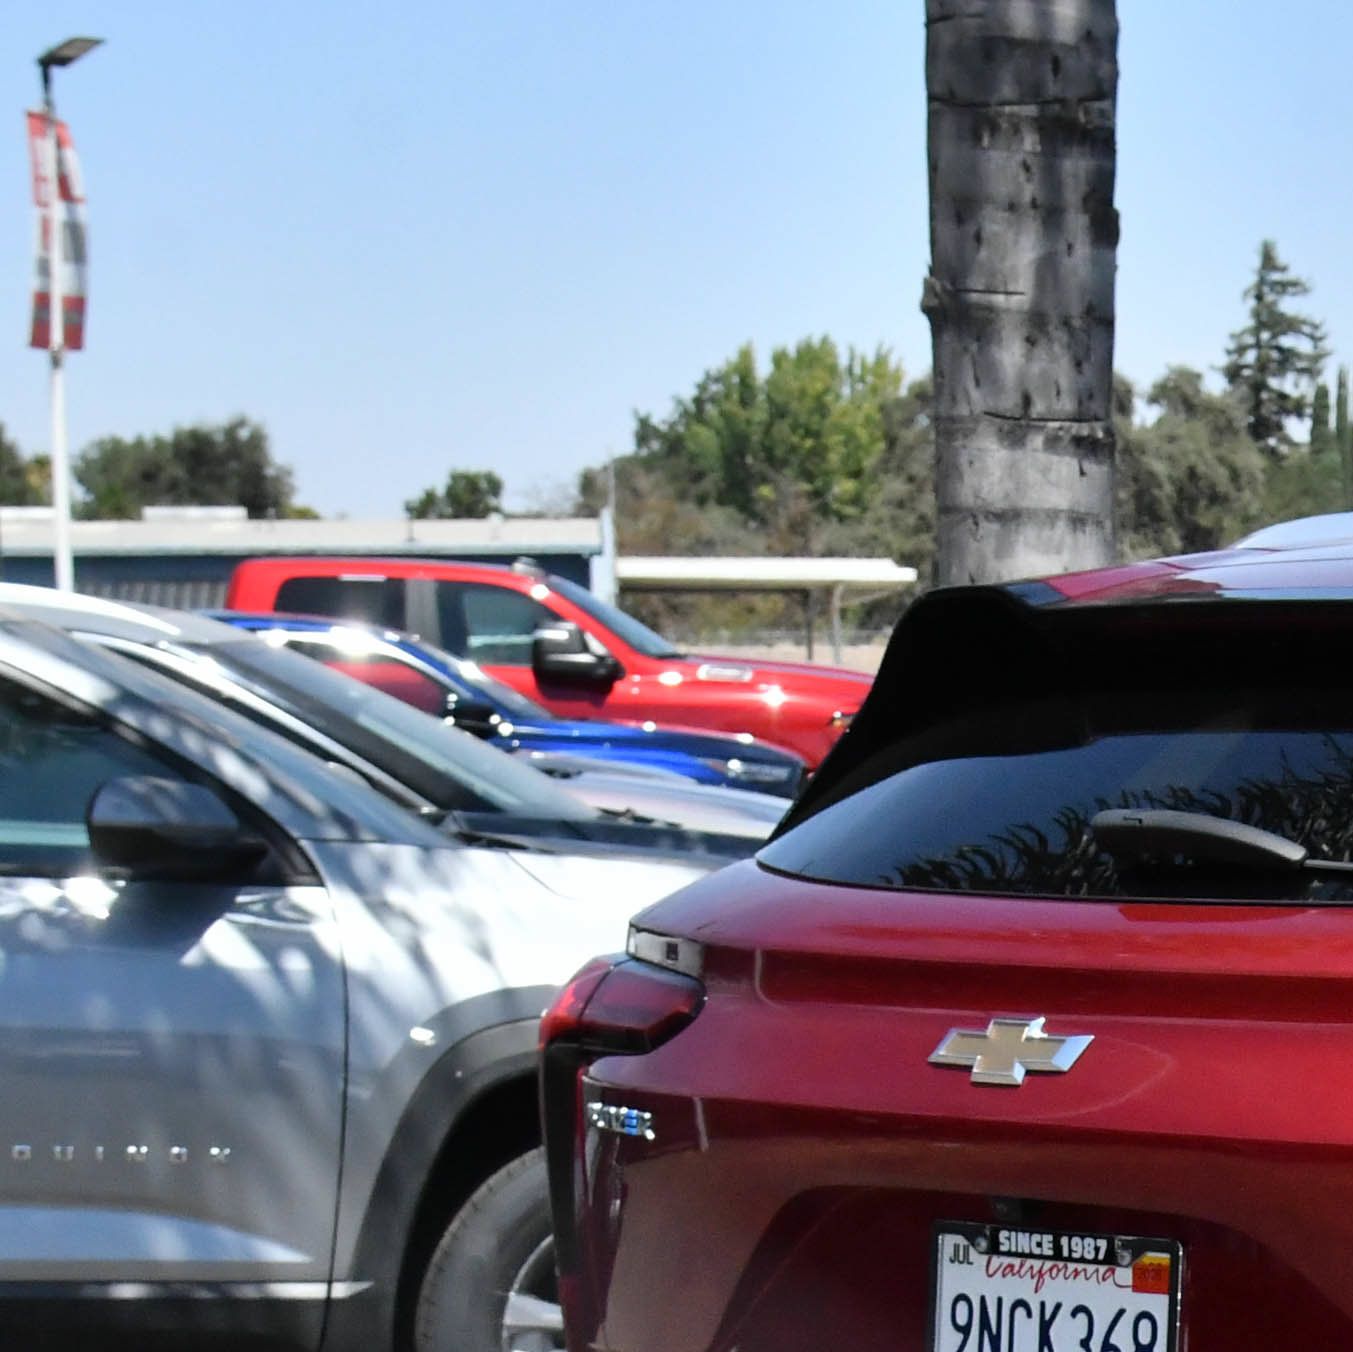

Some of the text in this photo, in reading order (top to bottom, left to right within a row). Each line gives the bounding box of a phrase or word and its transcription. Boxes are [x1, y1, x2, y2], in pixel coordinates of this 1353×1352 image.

[949, 1242, 974, 1266] JUL
[998, 1230, 1108, 1261] SINCE 1987
[985, 1254, 1134, 1294] California
